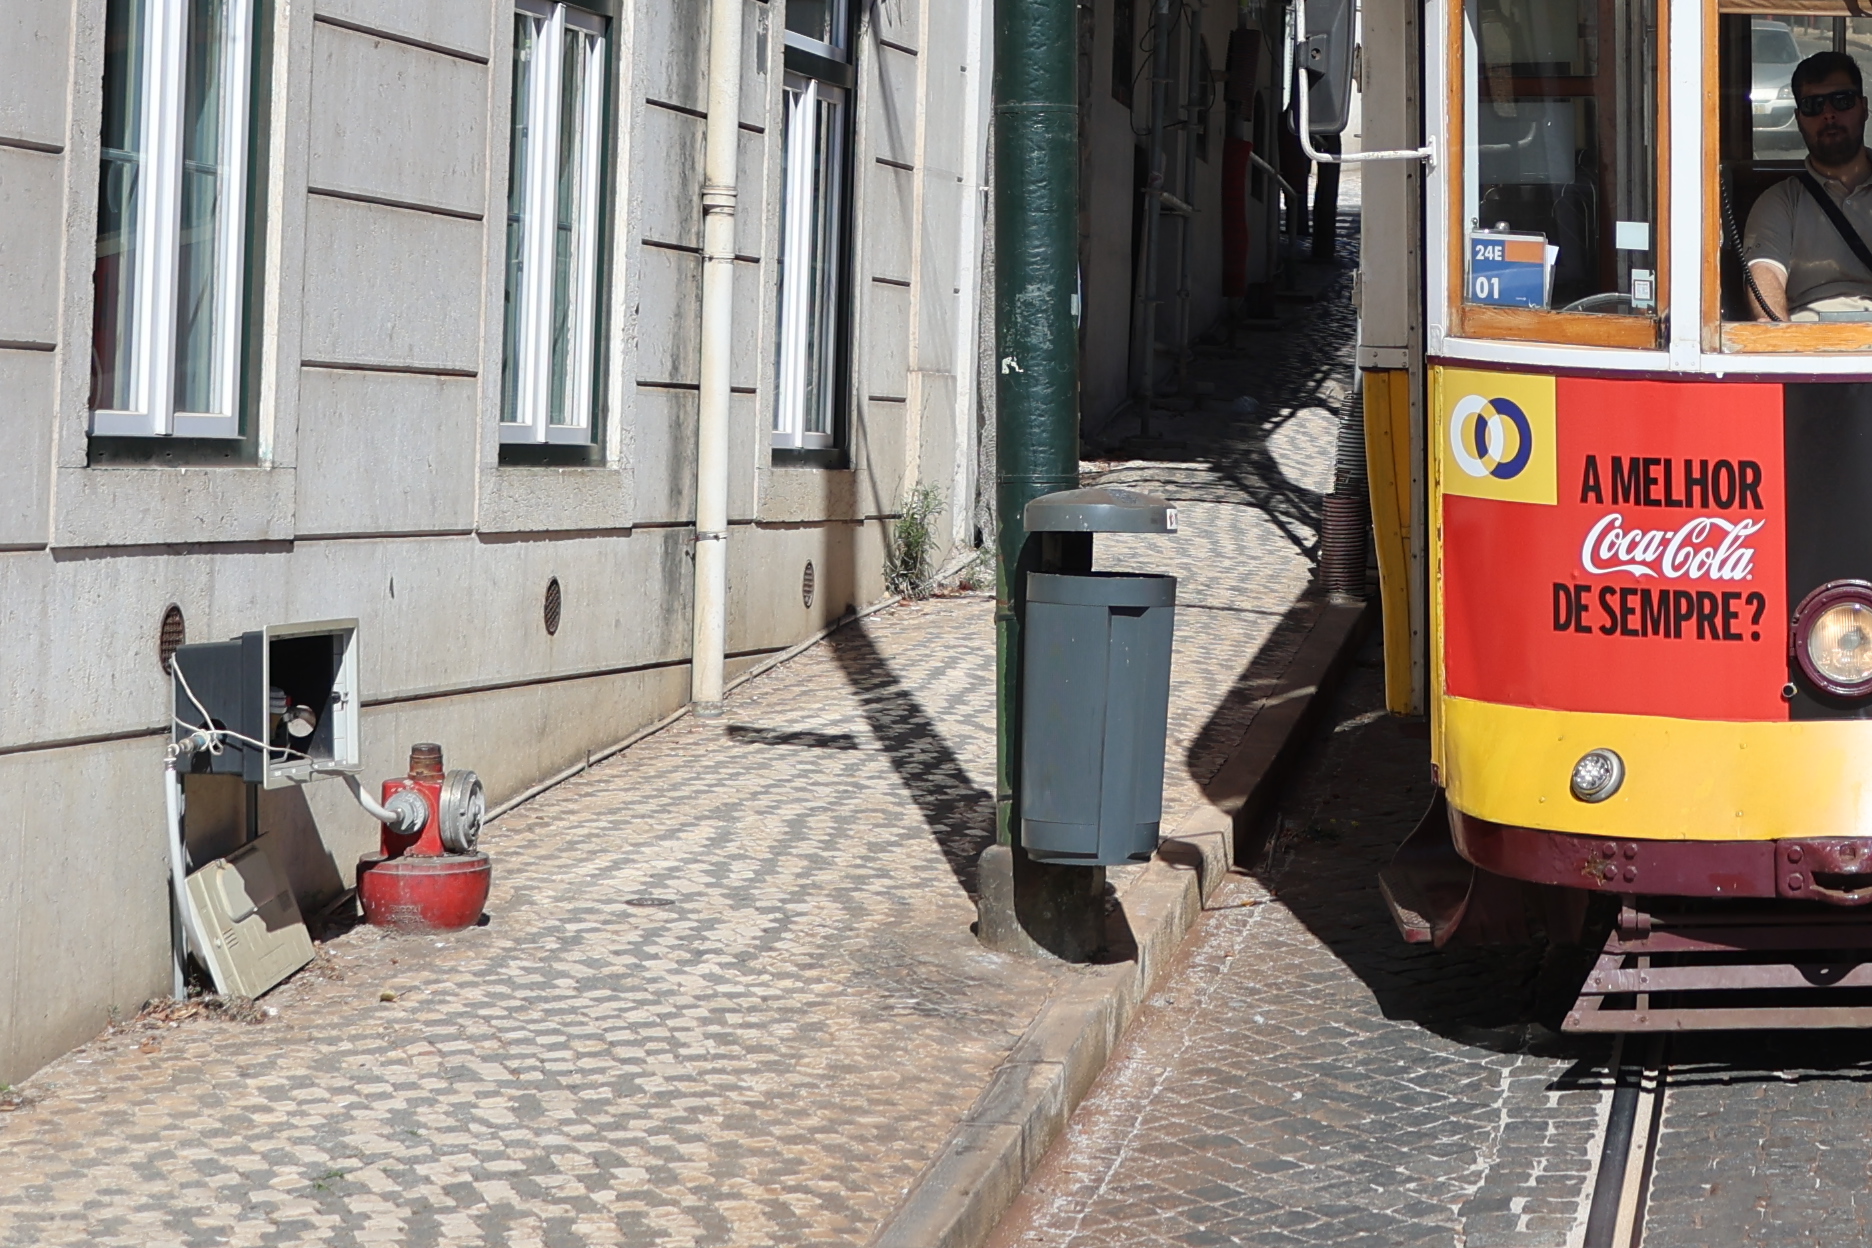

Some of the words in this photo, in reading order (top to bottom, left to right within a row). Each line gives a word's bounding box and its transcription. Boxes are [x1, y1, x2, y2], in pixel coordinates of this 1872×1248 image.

[1475, 244, 1502, 261] 24E
[1475, 277, 1499, 299] 01
[1580, 454, 1604, 504] A
[1611, 455, 1764, 510] MELHOR
[1580, 512, 1766, 581] Coca-Cola
[1552, 582, 1592, 634] DE
[1599, 584, 1766, 642] SEMPRE?
